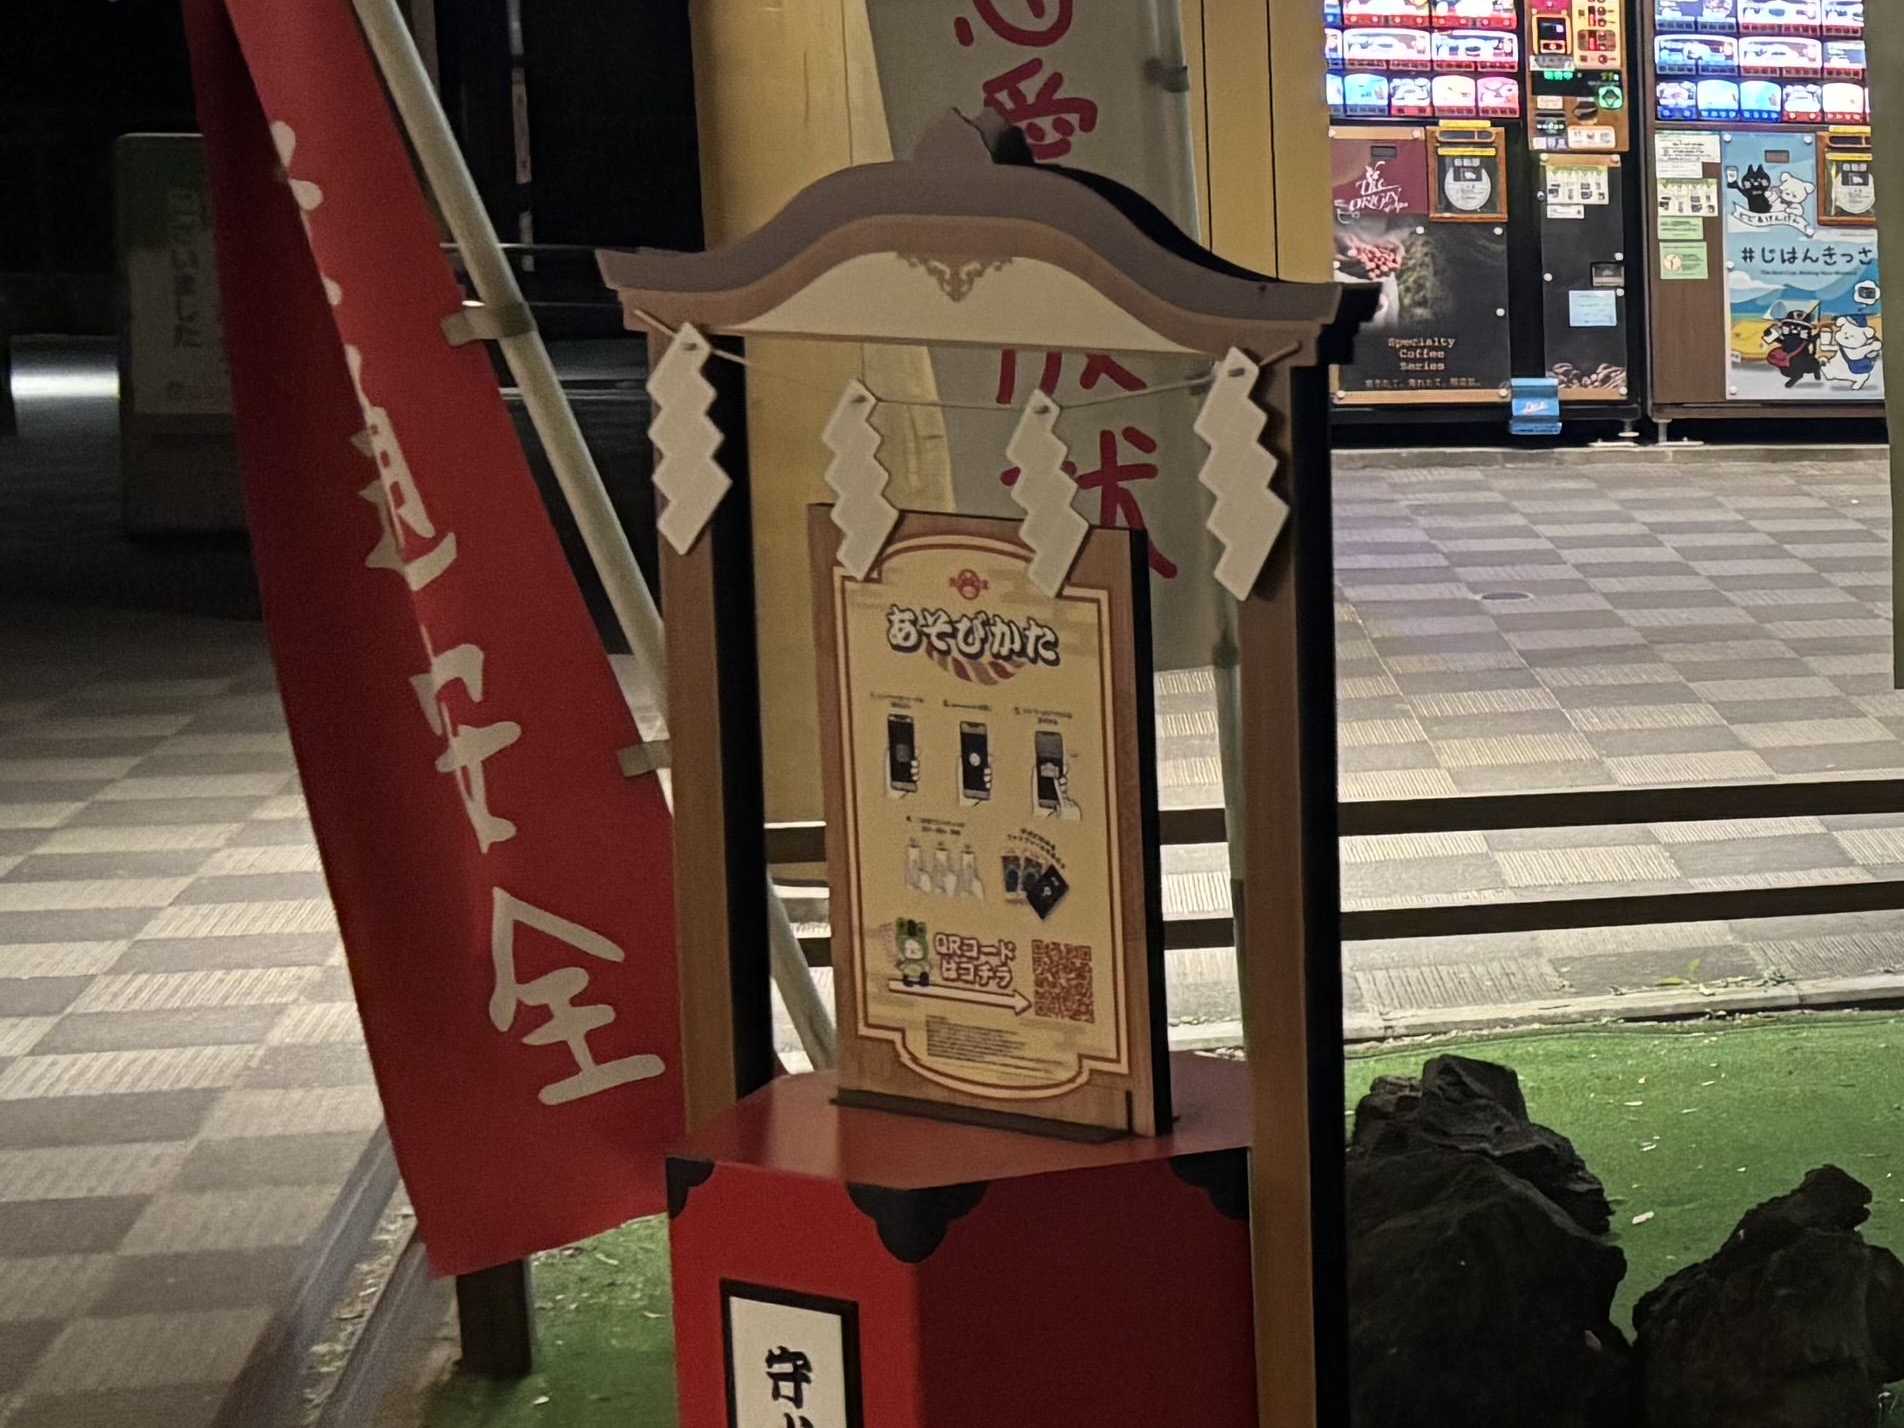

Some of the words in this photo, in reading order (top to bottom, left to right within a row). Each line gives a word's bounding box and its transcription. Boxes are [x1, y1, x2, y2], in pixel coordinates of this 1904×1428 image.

[1741, 245, 1873, 266] #じはんきっさ
[1388, 337, 1456, 349] Specialty
[1399, 349, 1445, 359] Coffee
[1400, 361, 1445, 371] Series
[886, 604, 1061, 666] あそびかた
[933, 931, 1017, 963] QRコード
[940, 956, 1013, 990] はコチラ
